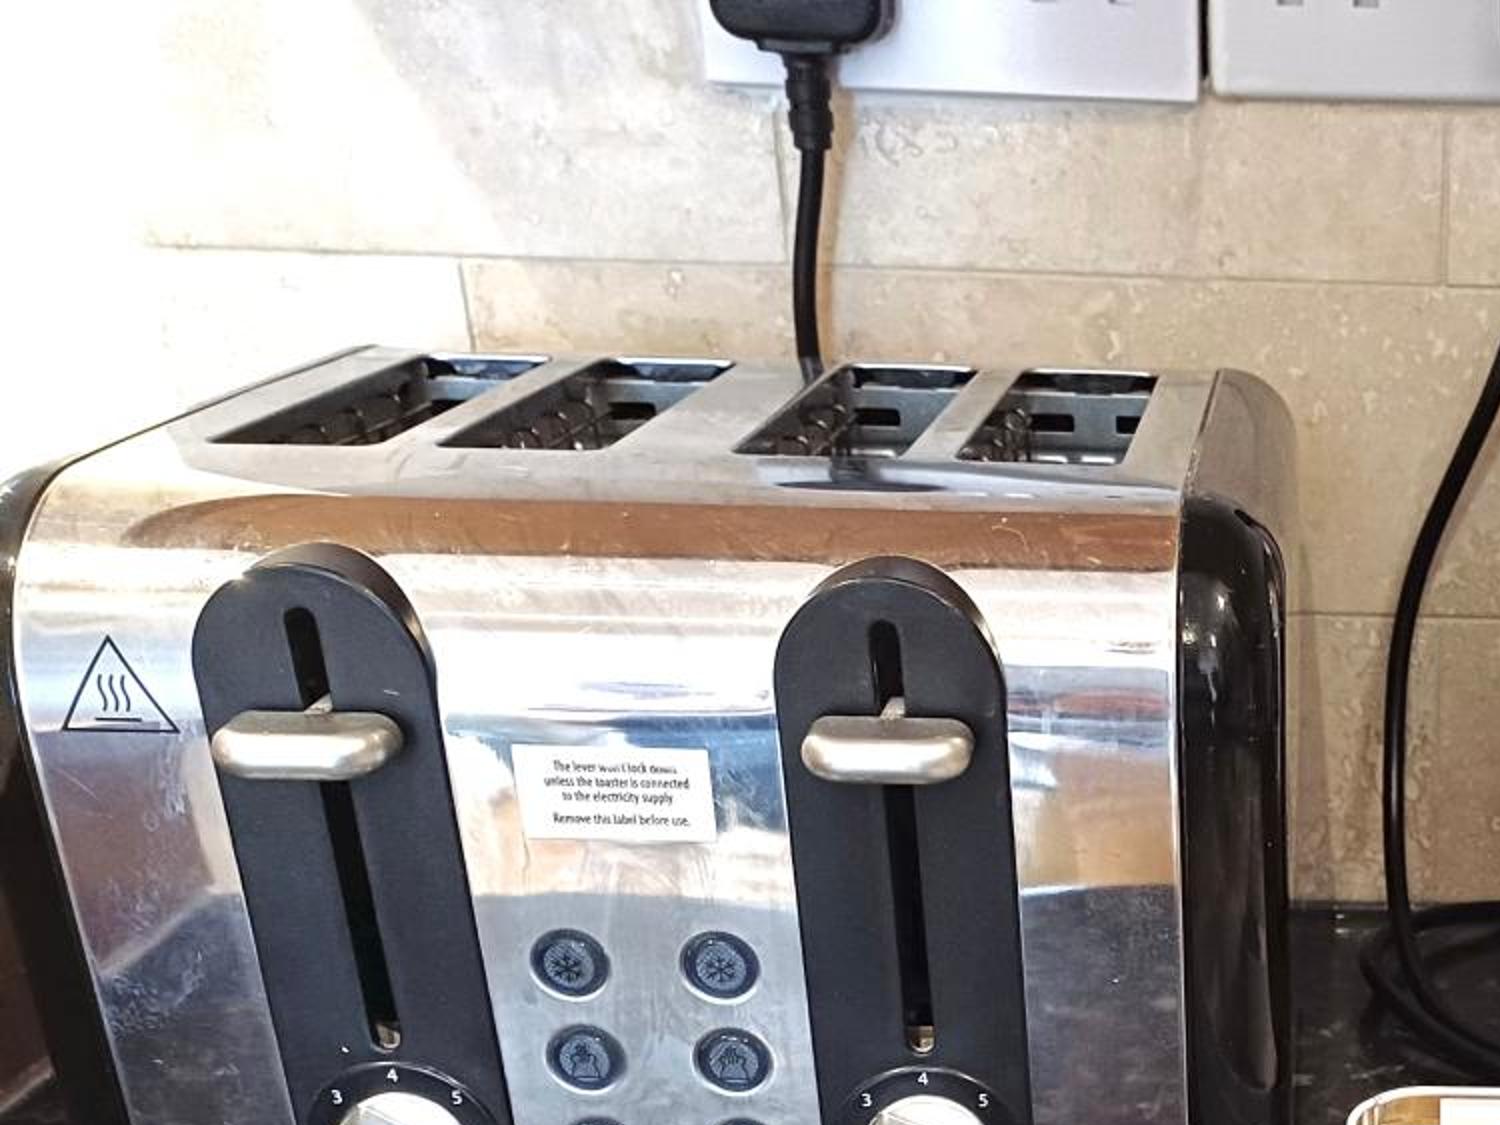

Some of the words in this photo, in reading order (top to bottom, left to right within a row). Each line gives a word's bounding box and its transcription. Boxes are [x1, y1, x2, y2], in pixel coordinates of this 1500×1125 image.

[553, 812, 592, 824] Remove
[387, 1068, 399, 1083] 4
[917, 1071, 930, 1086] 4
[331, 1089, 343, 1105] 3
[452, 1091, 463, 1105] 5
[860, 1093, 872, 1107] 3
[978, 1094, 989, 1107] 5
